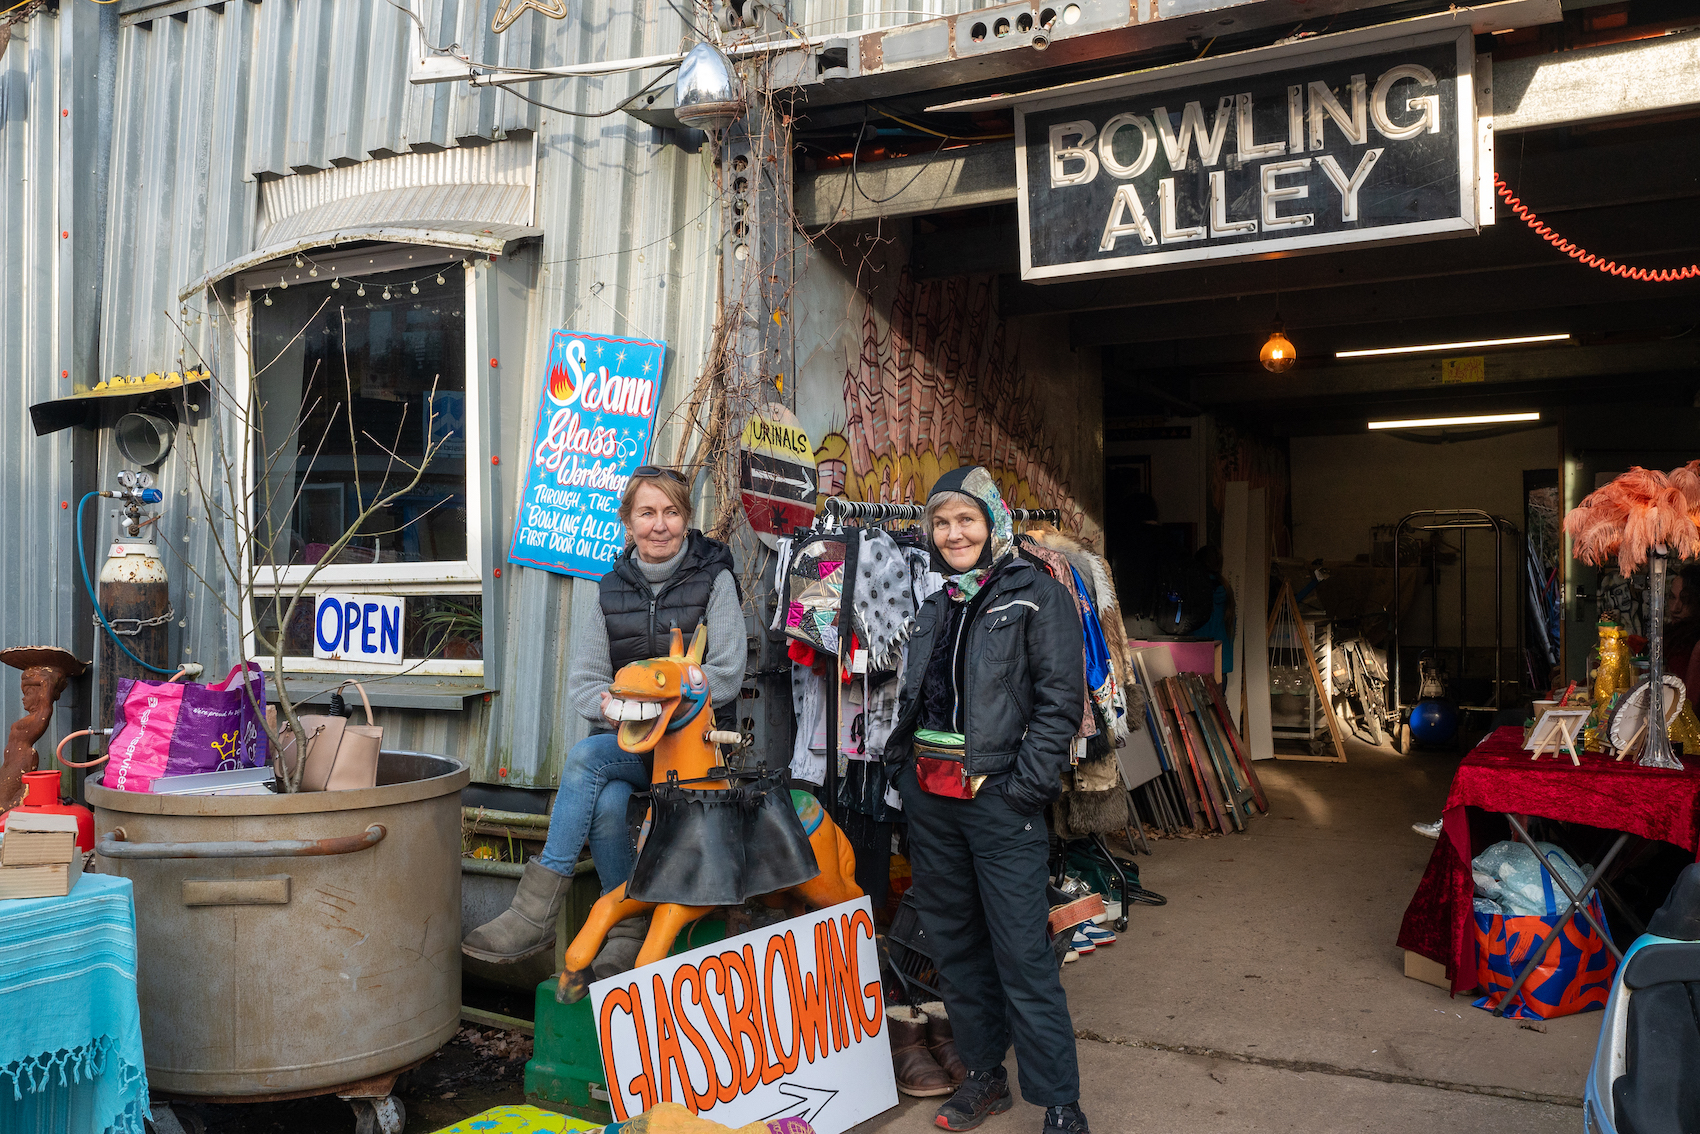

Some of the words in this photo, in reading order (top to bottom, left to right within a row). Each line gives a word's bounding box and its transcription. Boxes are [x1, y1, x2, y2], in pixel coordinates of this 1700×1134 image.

[1048, 63, 1441, 189] BOWLING
[1098, 147, 1385, 253] ALLEY
[547, 340, 653, 418] Swann
[535, 408, 637, 472] Glass
[753, 421, 807, 453] URINALS
[534, 484, 581, 511] THROUGH
[557, 454, 630, 499] Workshop
[519, 527, 548, 548] FIRST
[549, 533, 576, 555] DOOR
[576, 539, 592, 558] ON
[316, 597, 400, 655] OPEN
[600, 908, 883, 1122] GLASSBLOWING
